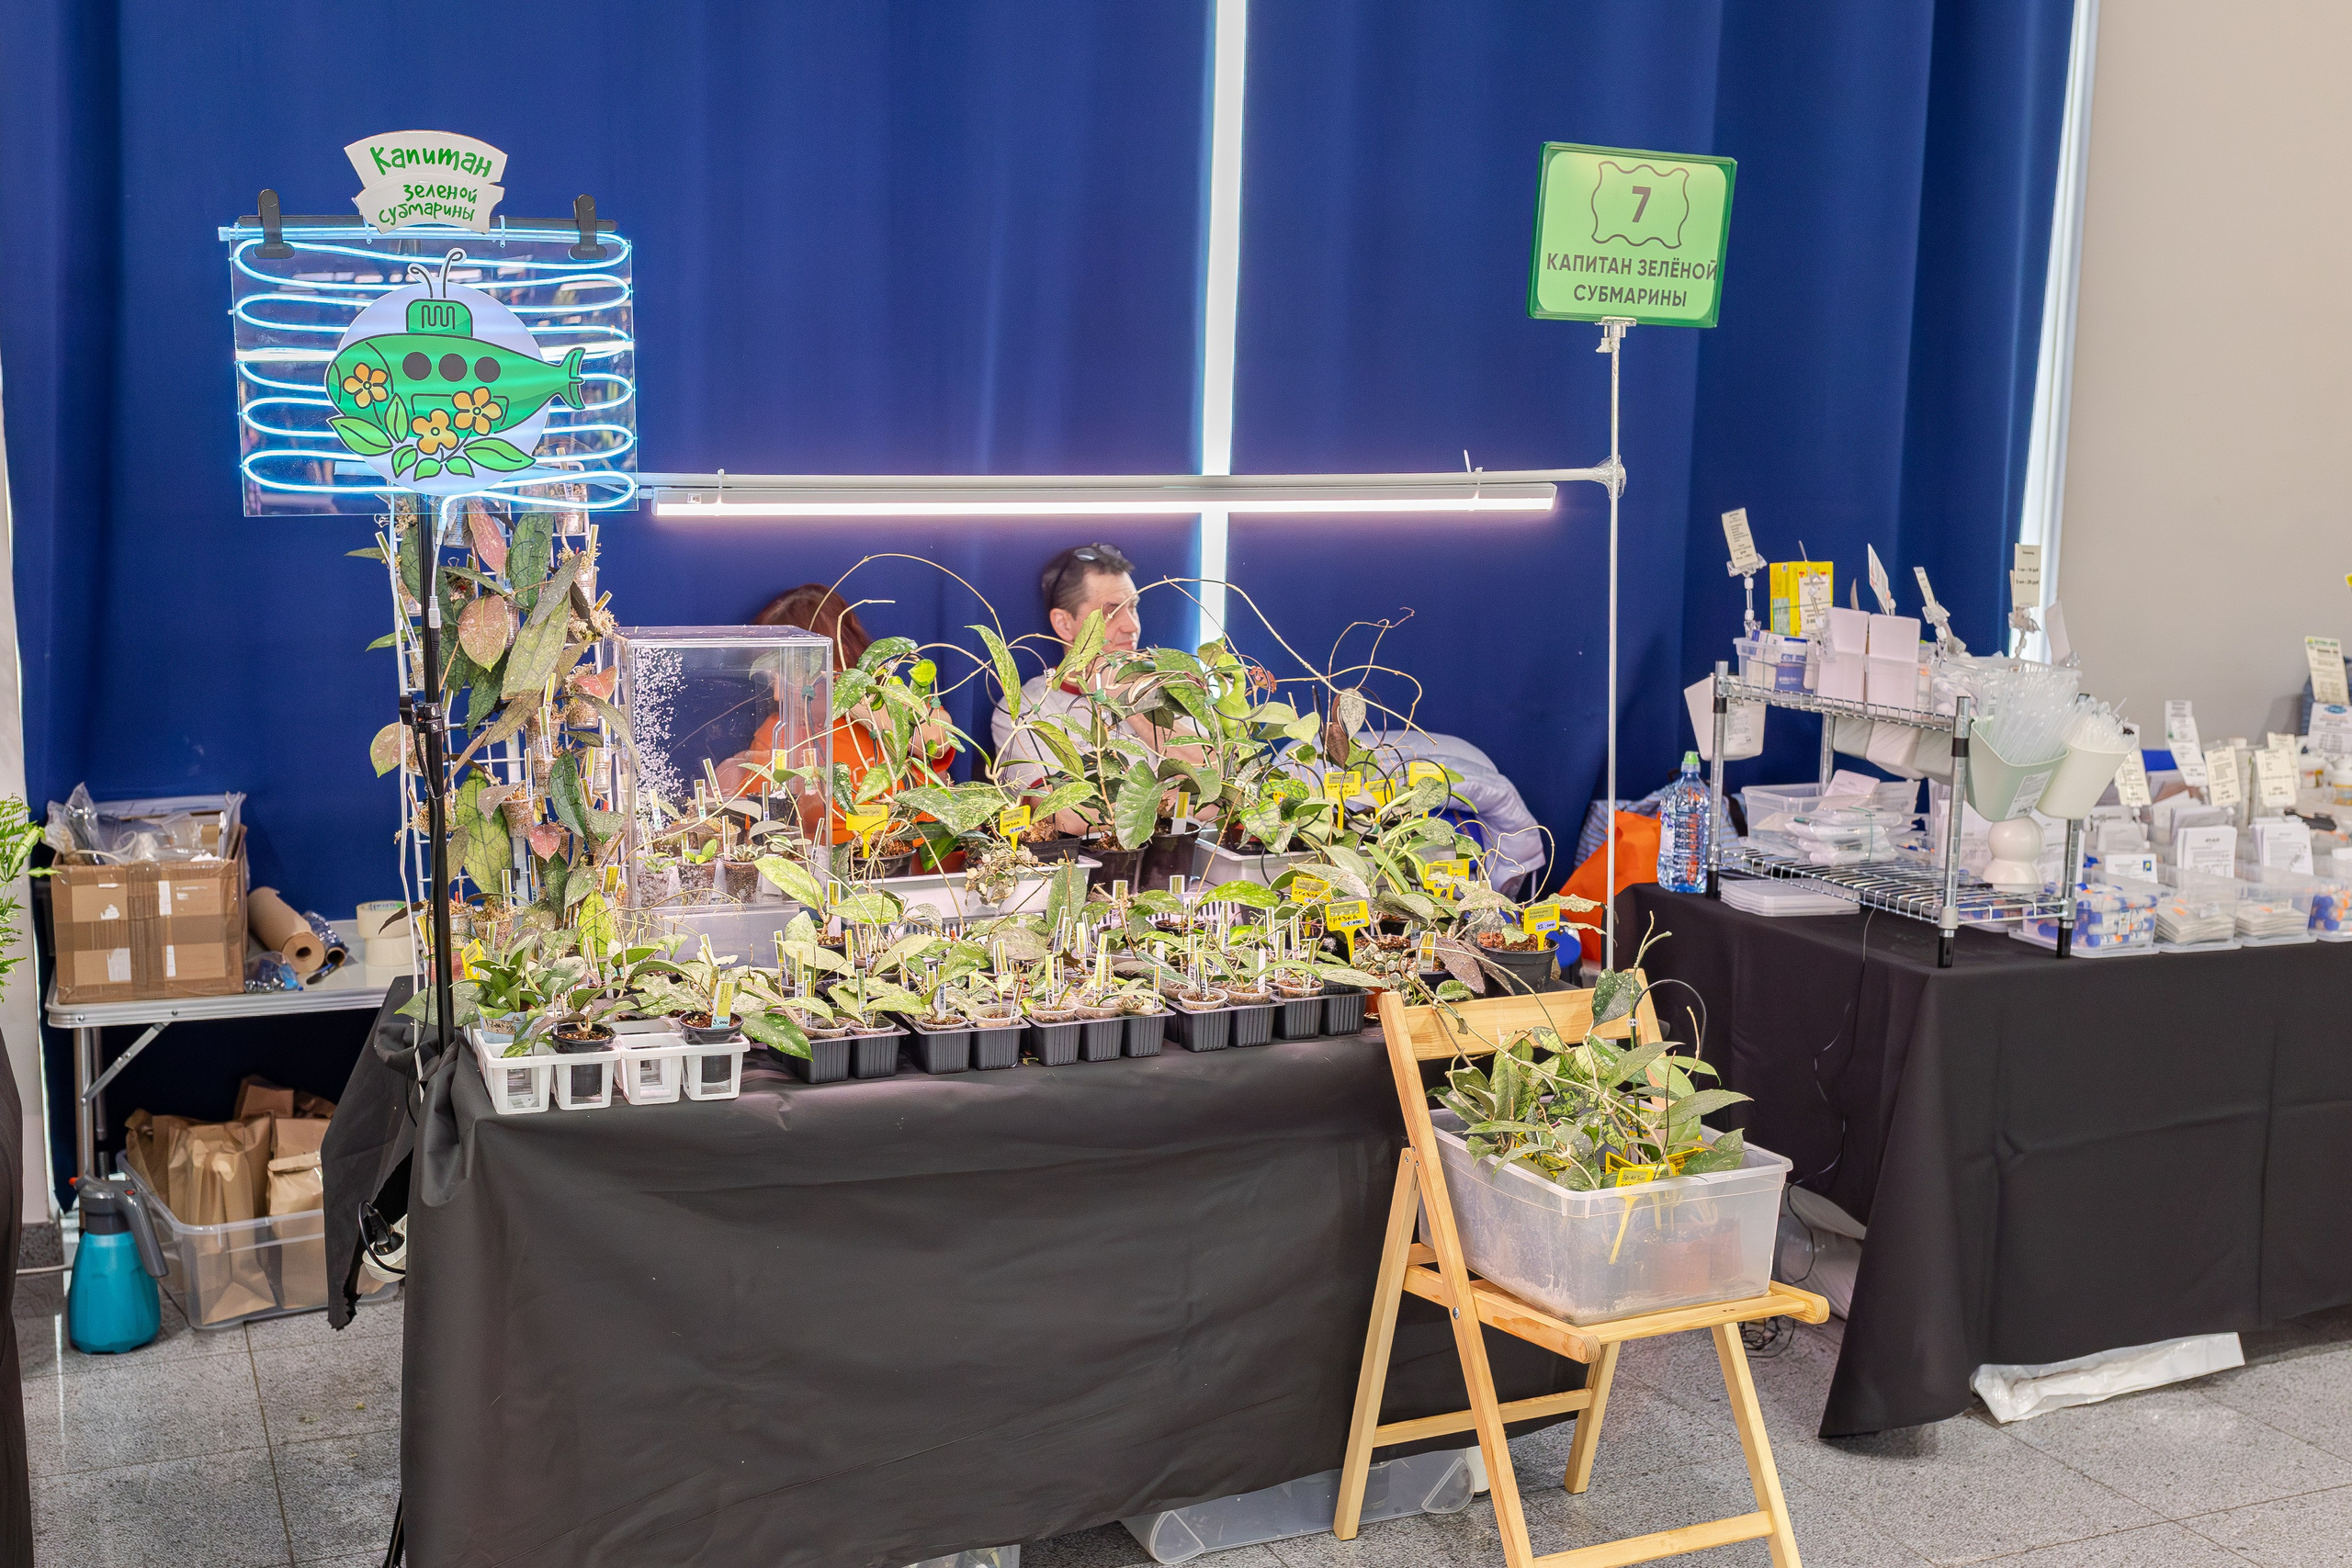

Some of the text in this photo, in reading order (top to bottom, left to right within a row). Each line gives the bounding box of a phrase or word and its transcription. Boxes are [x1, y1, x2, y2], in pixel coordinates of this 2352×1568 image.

[369, 146, 492, 178] Капитан
[403, 184, 478, 205] зеленой
[1632, 186, 1652, 223] 7
[379, 202, 476, 226] субмарины
[1546, 253, 1718, 280] КАПИТАН ЗЕЛЁНОЙ
[1573, 284, 1688, 307] СУБМАРИНЫ
